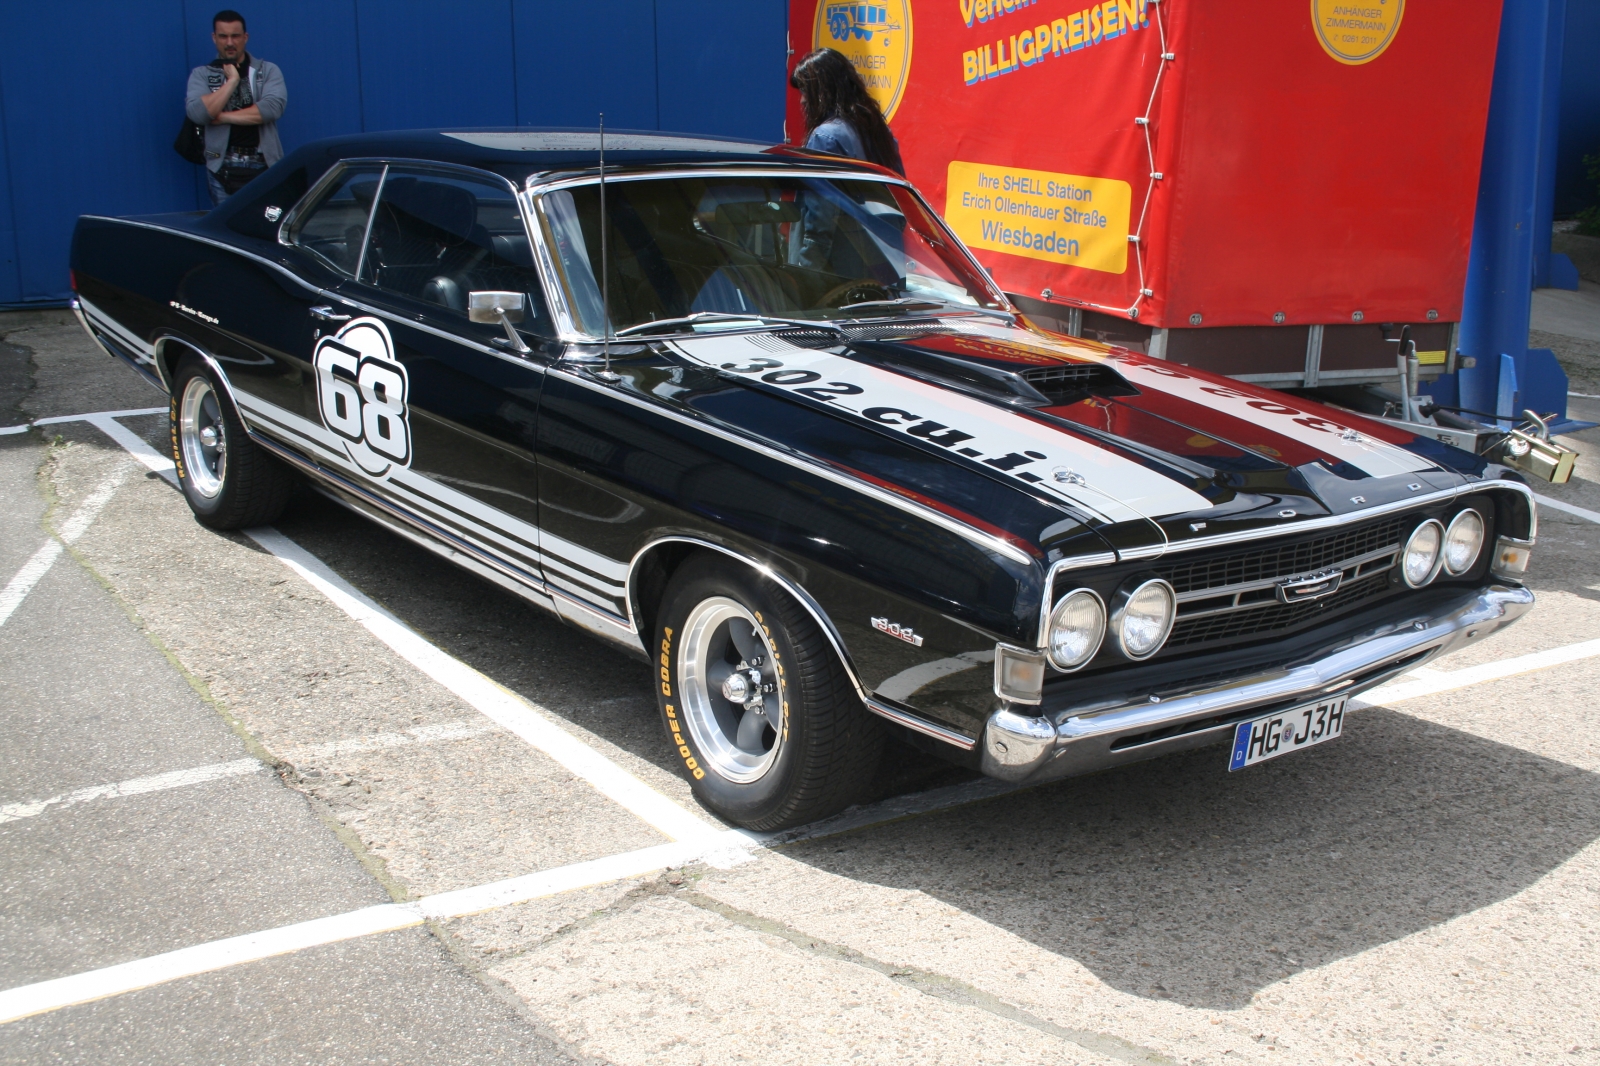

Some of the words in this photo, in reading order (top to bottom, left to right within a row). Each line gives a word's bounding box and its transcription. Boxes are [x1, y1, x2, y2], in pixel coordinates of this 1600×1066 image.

[1326, 17, 1387, 32] ZIMMERMANN
[1333, 5, 1382, 19] ANHÄNGER
[846, 50, 887, 69] HÄNGER
[963, 0, 1149, 86] BILLIGPREISEN!
[978, 172, 1000, 189] Ihre
[1003, 175, 1043, 195] SHELL
[1046, 180, 1092, 202] Station
[962, 191, 991, 210] Erich
[994, 196, 1060, 221] Ollenhauer
[1063, 206, 1107, 229] Straße
[981, 219, 1080, 257] Wiesbaden
[720, 358, 865, 402] 302
[315, 341, 410, 465] 68
[1189, 482, 1422, 532] FORD
[877, 617, 914, 643] 302
[659, 626, 674, 697] COBRA
[665, 704, 706, 780] COOPER
[1247, 718, 1283, 760] HG
[1294, 700, 1345, 745] J3H
[1235, 750, 1243, 761] D
